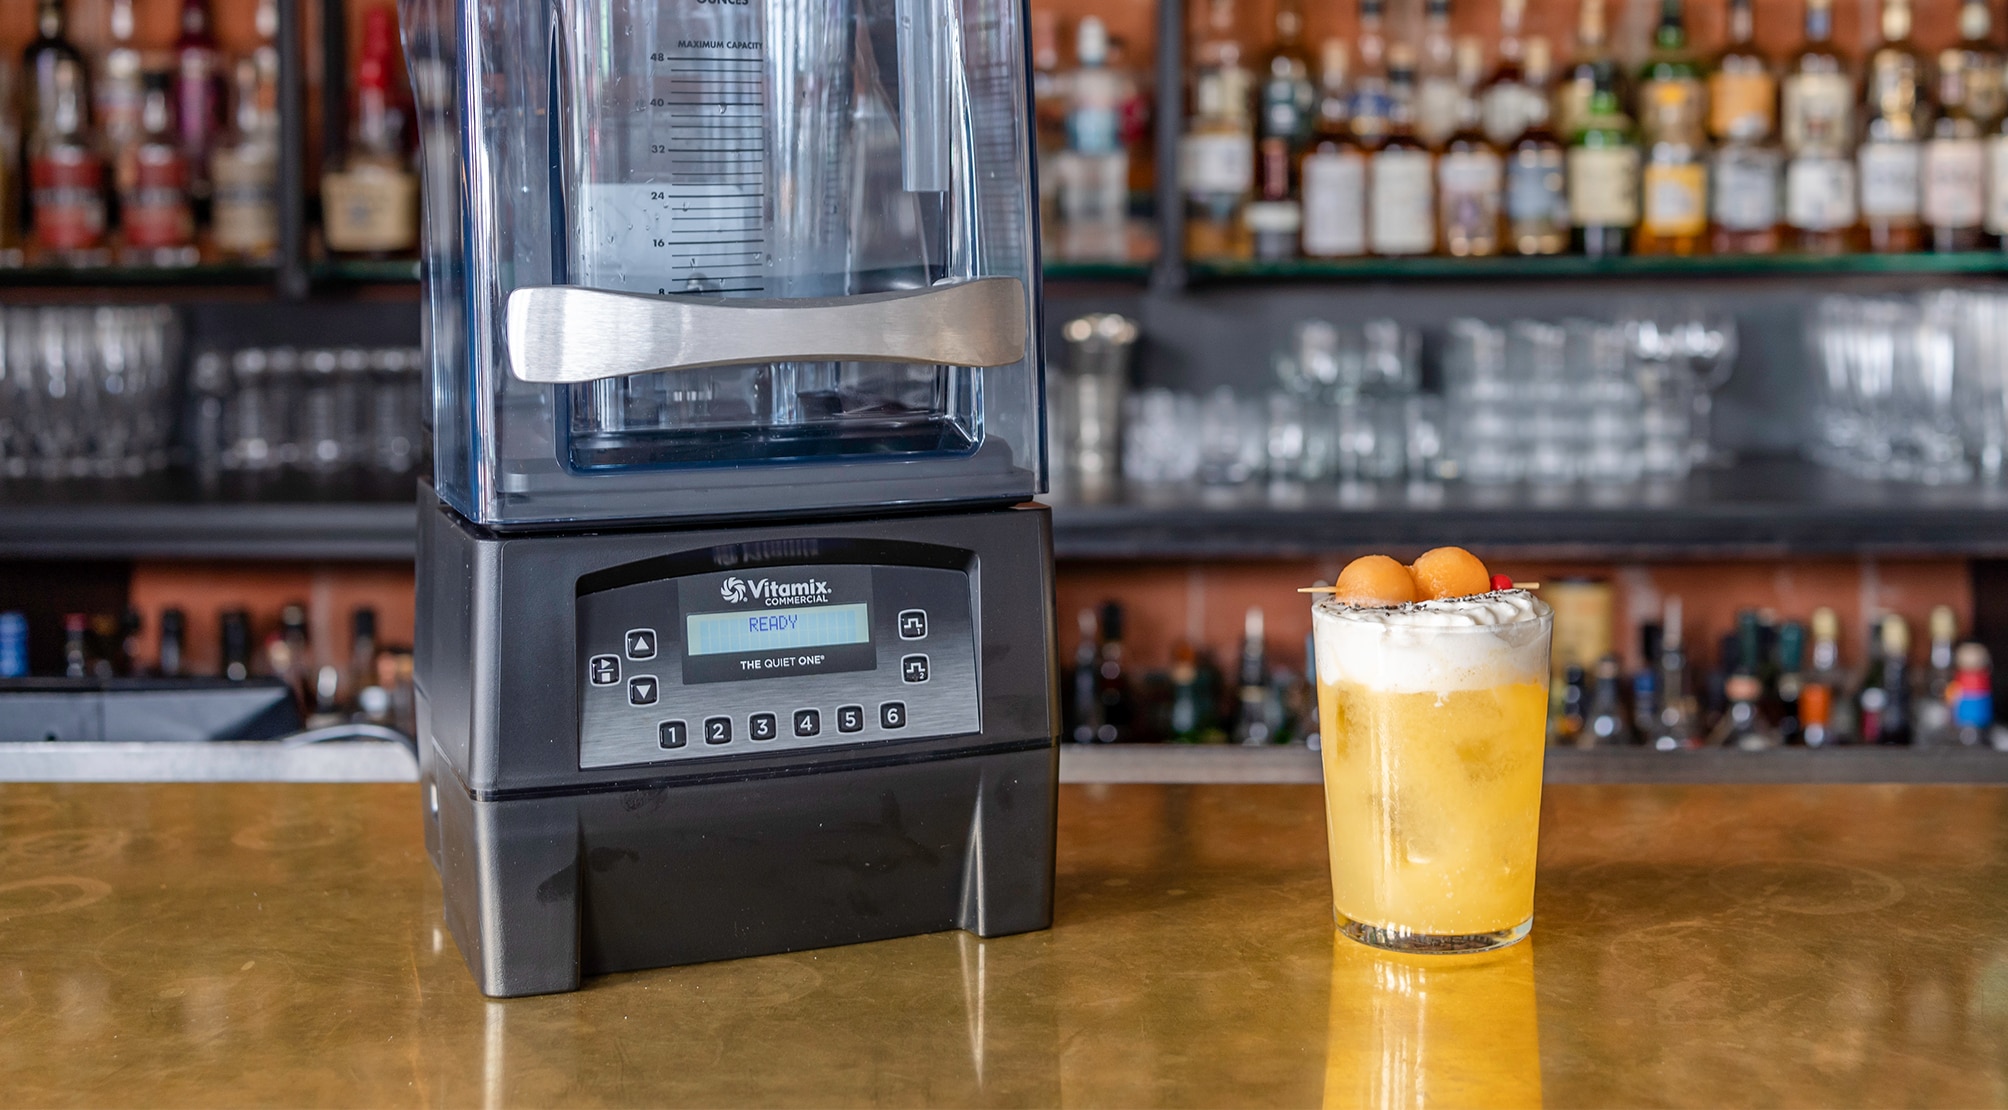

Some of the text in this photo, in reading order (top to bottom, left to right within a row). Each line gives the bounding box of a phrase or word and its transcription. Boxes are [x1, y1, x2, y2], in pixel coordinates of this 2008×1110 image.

[677, 40, 763, 49] MAXIMUM CAPACITY
[650, 52, 665, 62] 48
[650, 98, 665, 107] 40
[651, 144, 666, 154] 32
[650, 191, 665, 200] 24
[652, 238, 665, 247] 16
[764, 594, 829, 606] COMMERCIAL
[749, 614, 798, 632] READY
[740, 659, 762, 670] THE
[764, 657, 796, 669] QUIET
[845, 711, 856, 727] 5
[887, 708, 899, 724] 6
[757, 718, 769, 735] 3
[800, 715, 813, 731] 4
[668, 726, 677, 743] 1
[712, 723, 725, 739] 2
